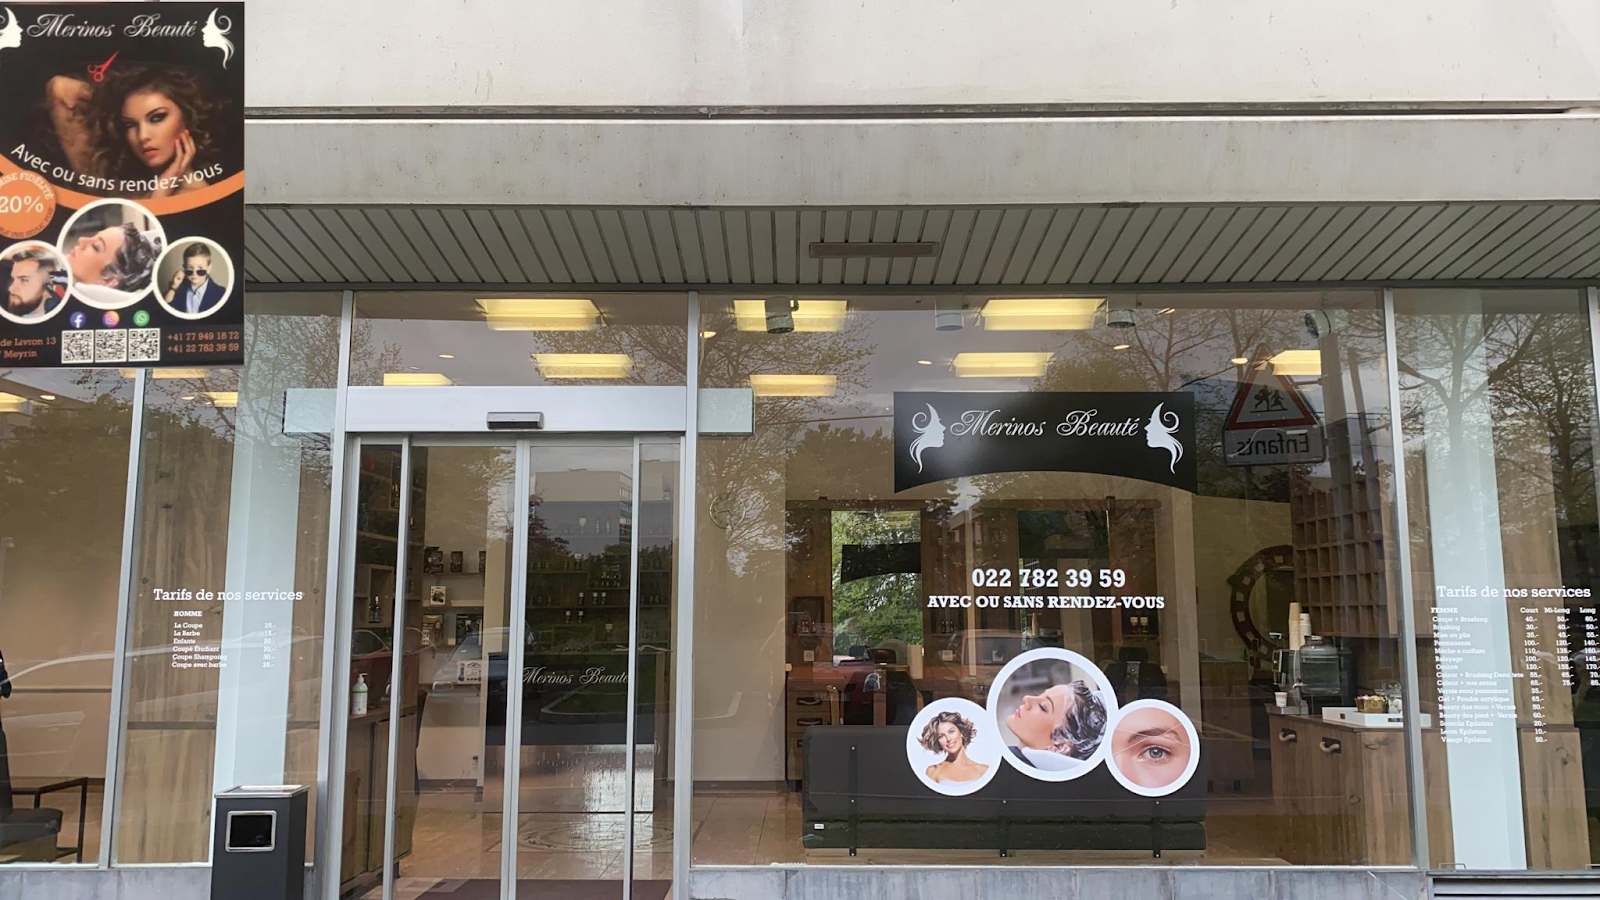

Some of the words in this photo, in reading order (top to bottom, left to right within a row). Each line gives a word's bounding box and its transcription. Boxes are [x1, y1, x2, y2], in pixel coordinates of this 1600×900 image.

[27, 14, 115, 37] Merinos
[124, 14, 198, 37] Beauté
[11, 143, 51, 173] Avec
[52, 166, 74, 182] ou
[78, 175, 115, 191] sans
[120, 162, 223, 192] rendez-vous
[15, 338, 44, 346] Livron
[46, 337, 57, 345] 13
[166, 332, 184, 341] +41
[186, 332, 196, 341] 77
[198, 332, 214, 341] 949
[217, 332, 227, 340] 18
[228, 332, 240, 340] 72
[166, 344, 184, 353] +41
[186, 344, 196, 352] 22
[198, 344, 214, 352] 782
[216, 343, 227, 352] 39
[228, 343, 240, 351] 59
[4, 350, 38, 360] Meyrin
[950, 409, 1047, 436] Merinos
[1056, 409, 1141, 436] Beauté
[972, 568, 1012, 588] 022
[1019, 568, 1059, 588] 782
[1066, 568, 1092, 588] 39
[1099, 568, 1126, 588] 59
[153, 588, 193, 601] Tarifs
[196, 589, 214, 601] de
[218, 591, 242, 601] nos
[245, 589, 303, 601] services
[1437, 585, 1478, 598] Tarifs
[1481, 585, 1499, 598] de
[1503, 588, 1528, 598] nos
[1532, 586, 1592, 598] services
[927, 595, 972, 609] AVEC
[975, 596, 1001, 609] OU
[1003, 596, 1045, 609] SANS
[1047, 596, 1166, 610] RENDEZ-VOUS
[1544, 607, 1571, 615] Mi-Long
[1579, 607, 1596, 615] Long
[183, 622, 203, 630] Coupe
[522, 667, 574, 684] Merinos
